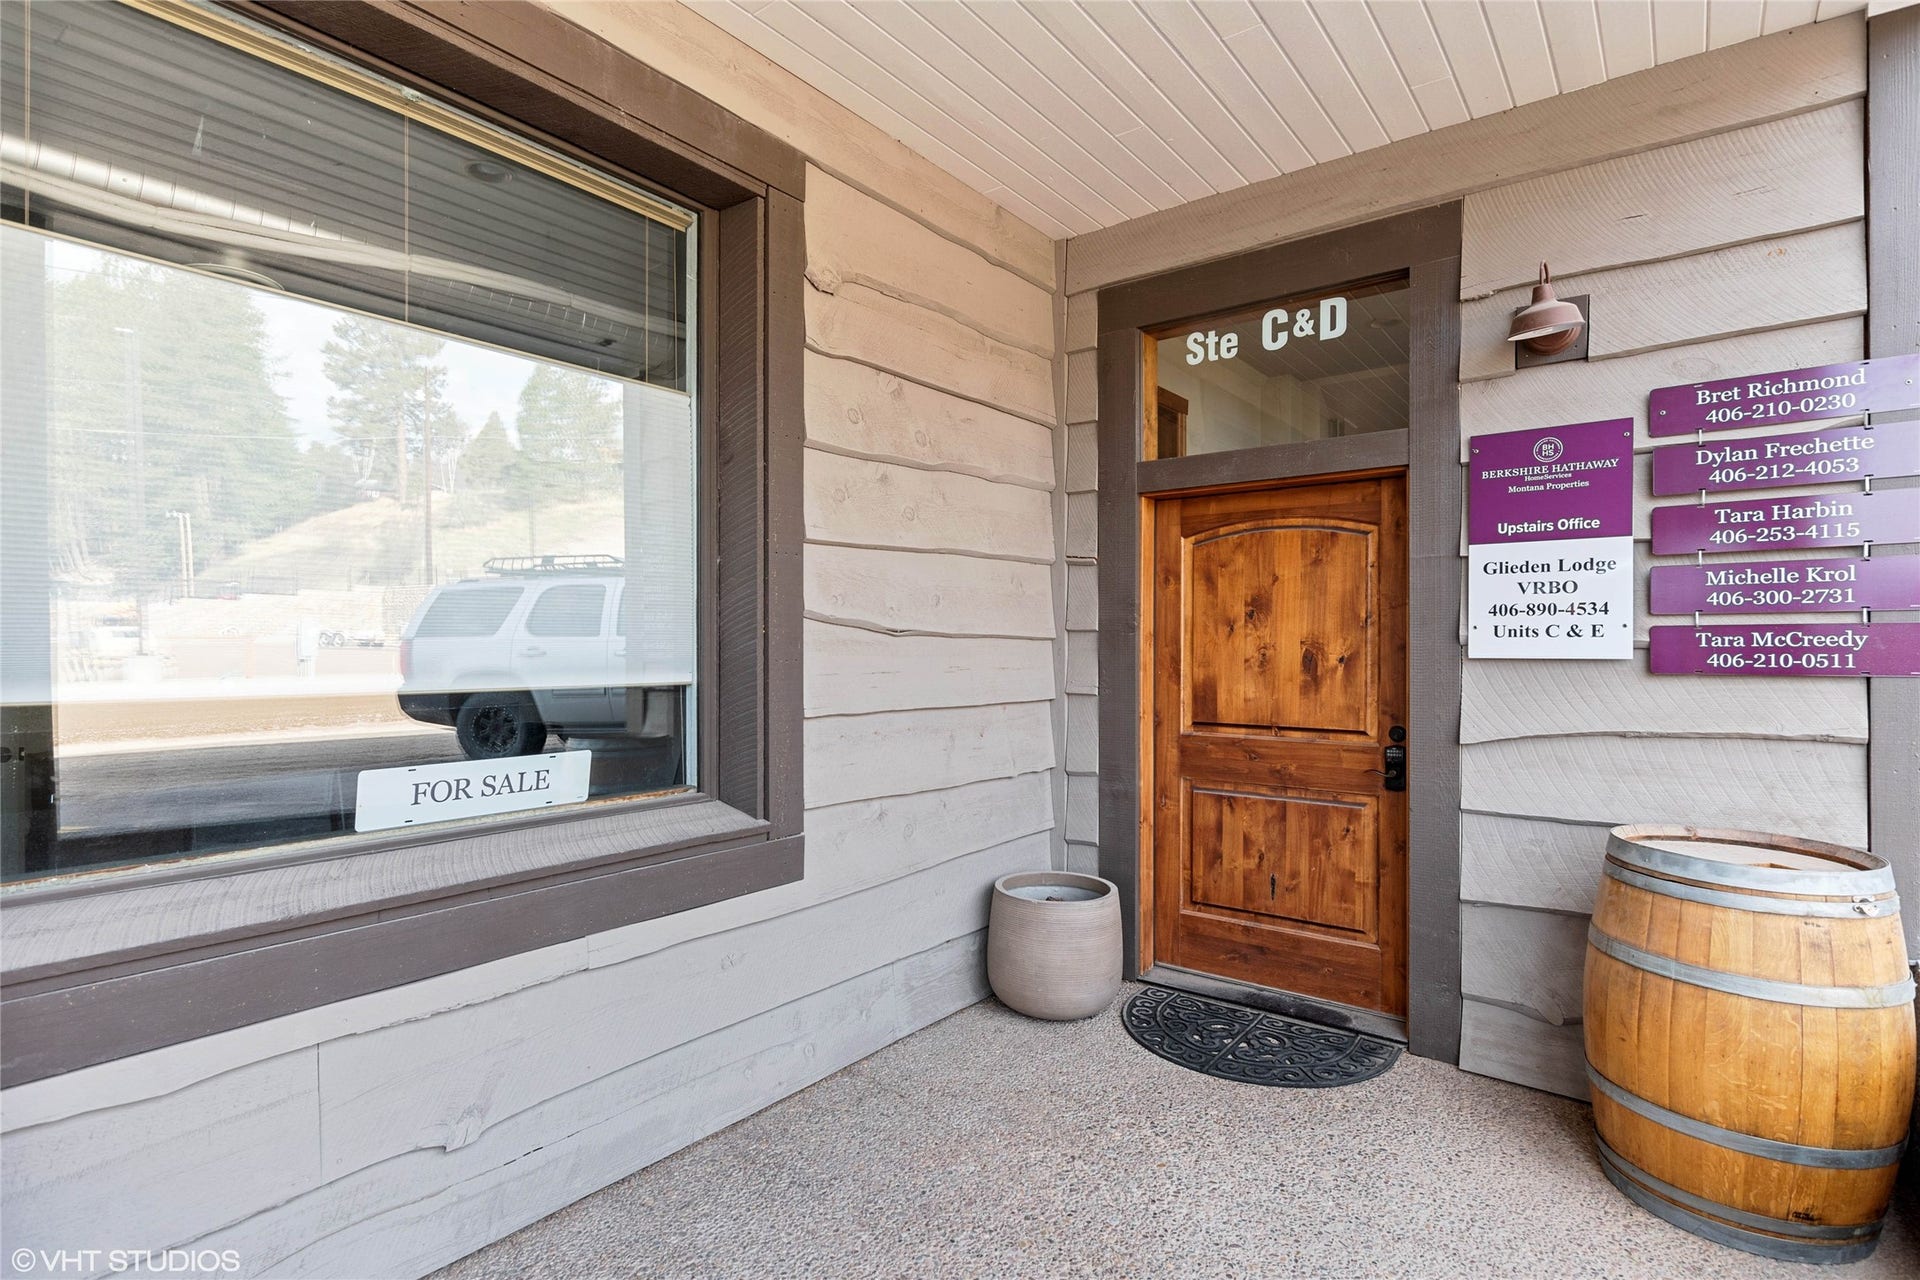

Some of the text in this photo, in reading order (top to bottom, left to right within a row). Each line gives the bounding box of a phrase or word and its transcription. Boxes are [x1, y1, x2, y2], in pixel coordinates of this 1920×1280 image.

[1185, 330, 1239, 366] Ste
[1696, 368, 1866, 406] Bret Richmond
[1705, 392, 1856, 424] 406-210-0230
[1696, 435, 1875, 467] Dylan Frechette
[1482, 459, 1619, 479] BERKSHIRE HATHAWAY
[1525, 473, 1572, 482] HomeServices
[1709, 457, 1860, 483] 406-212-4053
[1508, 480, 1590, 493] Montana Properties
[1714, 501, 1854, 524] Tara Harbin
[1498, 517, 1601, 536] Upstairs Office
[1709, 522, 1860, 544] 406-253-4115
[1483, 557, 1617, 576] Glieden Lodge
[1705, 565, 1856, 586] Michelle Krol
[1517, 580, 1579, 595] VRBO
[1706, 588, 1856, 606] 406-300-2731
[1488, 602, 1610, 617] 406-890-4534
[1493, 624, 1605, 638] Units C & E
[1695, 630, 1868, 651] Tara McCreedy
[1706, 653, 1856, 669] 406-210-0511
[411, 769, 551, 806] FOR SALE
